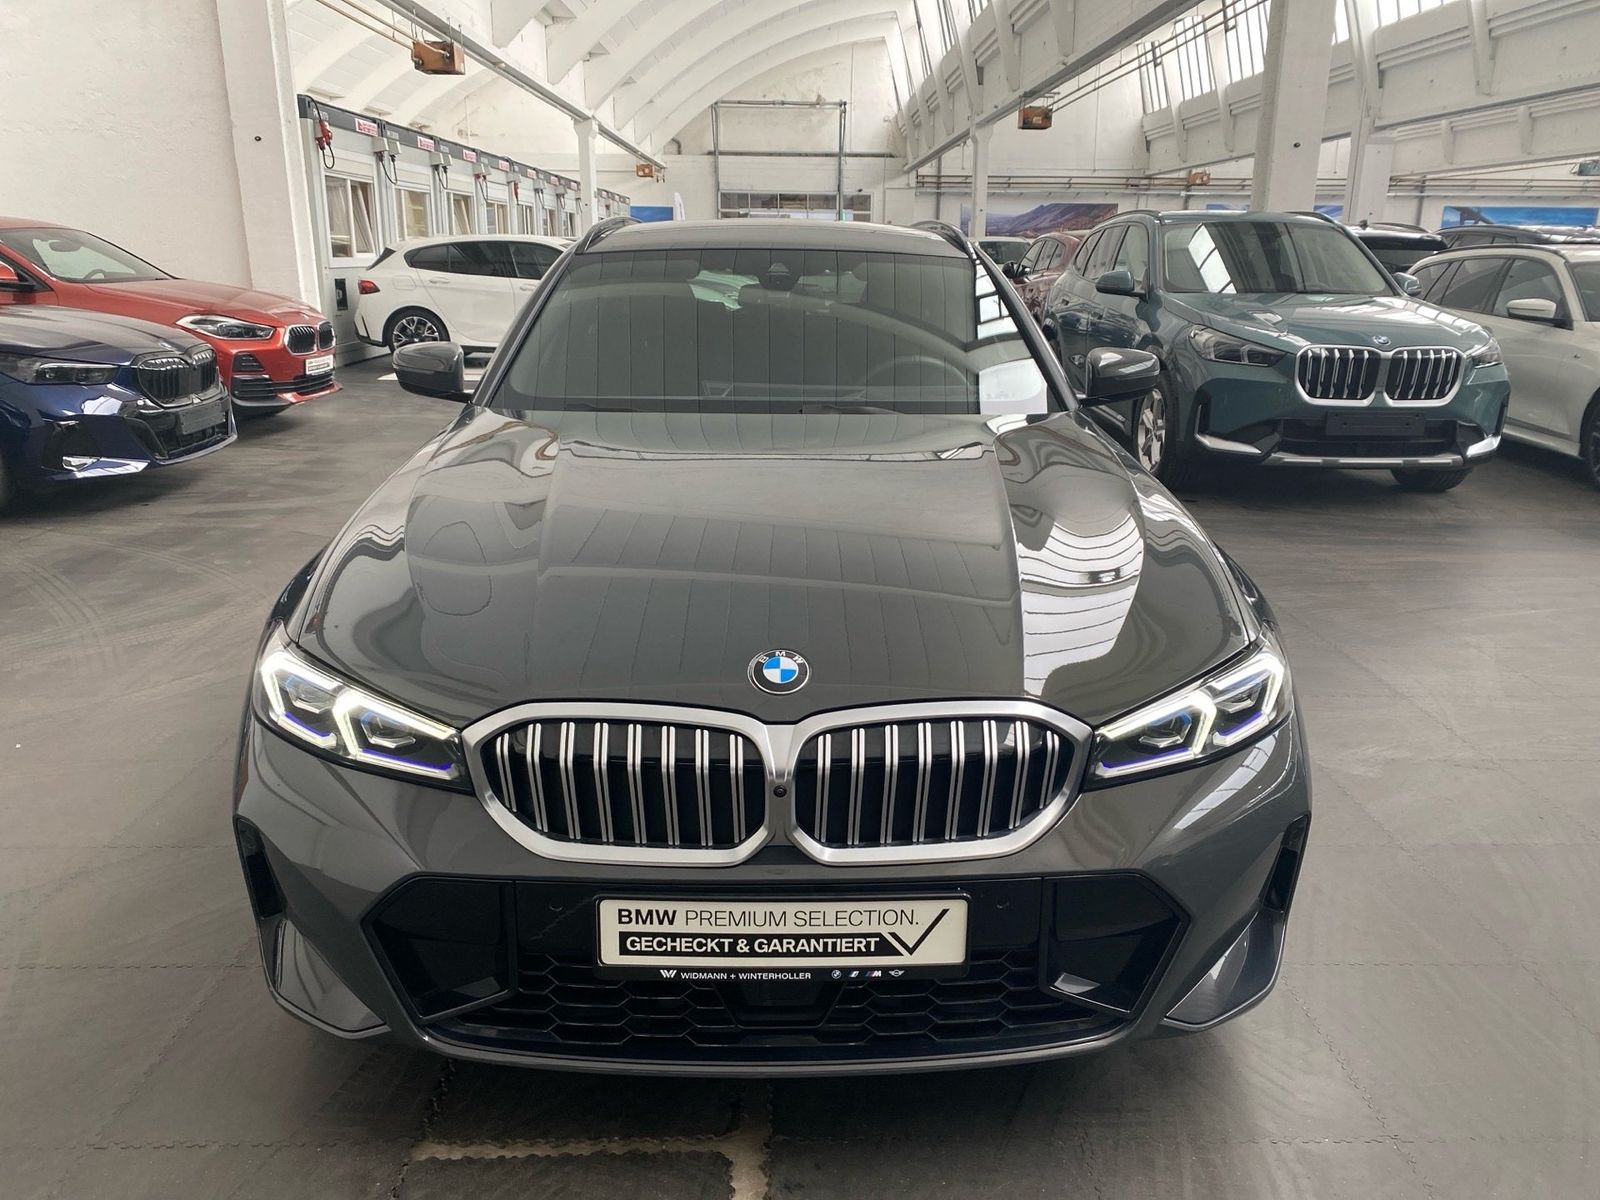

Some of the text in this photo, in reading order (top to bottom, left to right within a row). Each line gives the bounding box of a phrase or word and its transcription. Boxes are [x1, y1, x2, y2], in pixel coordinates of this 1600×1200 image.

[617, 908, 919, 927] BMW PREMIUM SELECTION.
[626, 936, 880, 953] GECHECKT & GARANTIERT
[681, 972, 727, 980] WIDMANN
[738, 972, 811, 980] WINTERHOLLER
